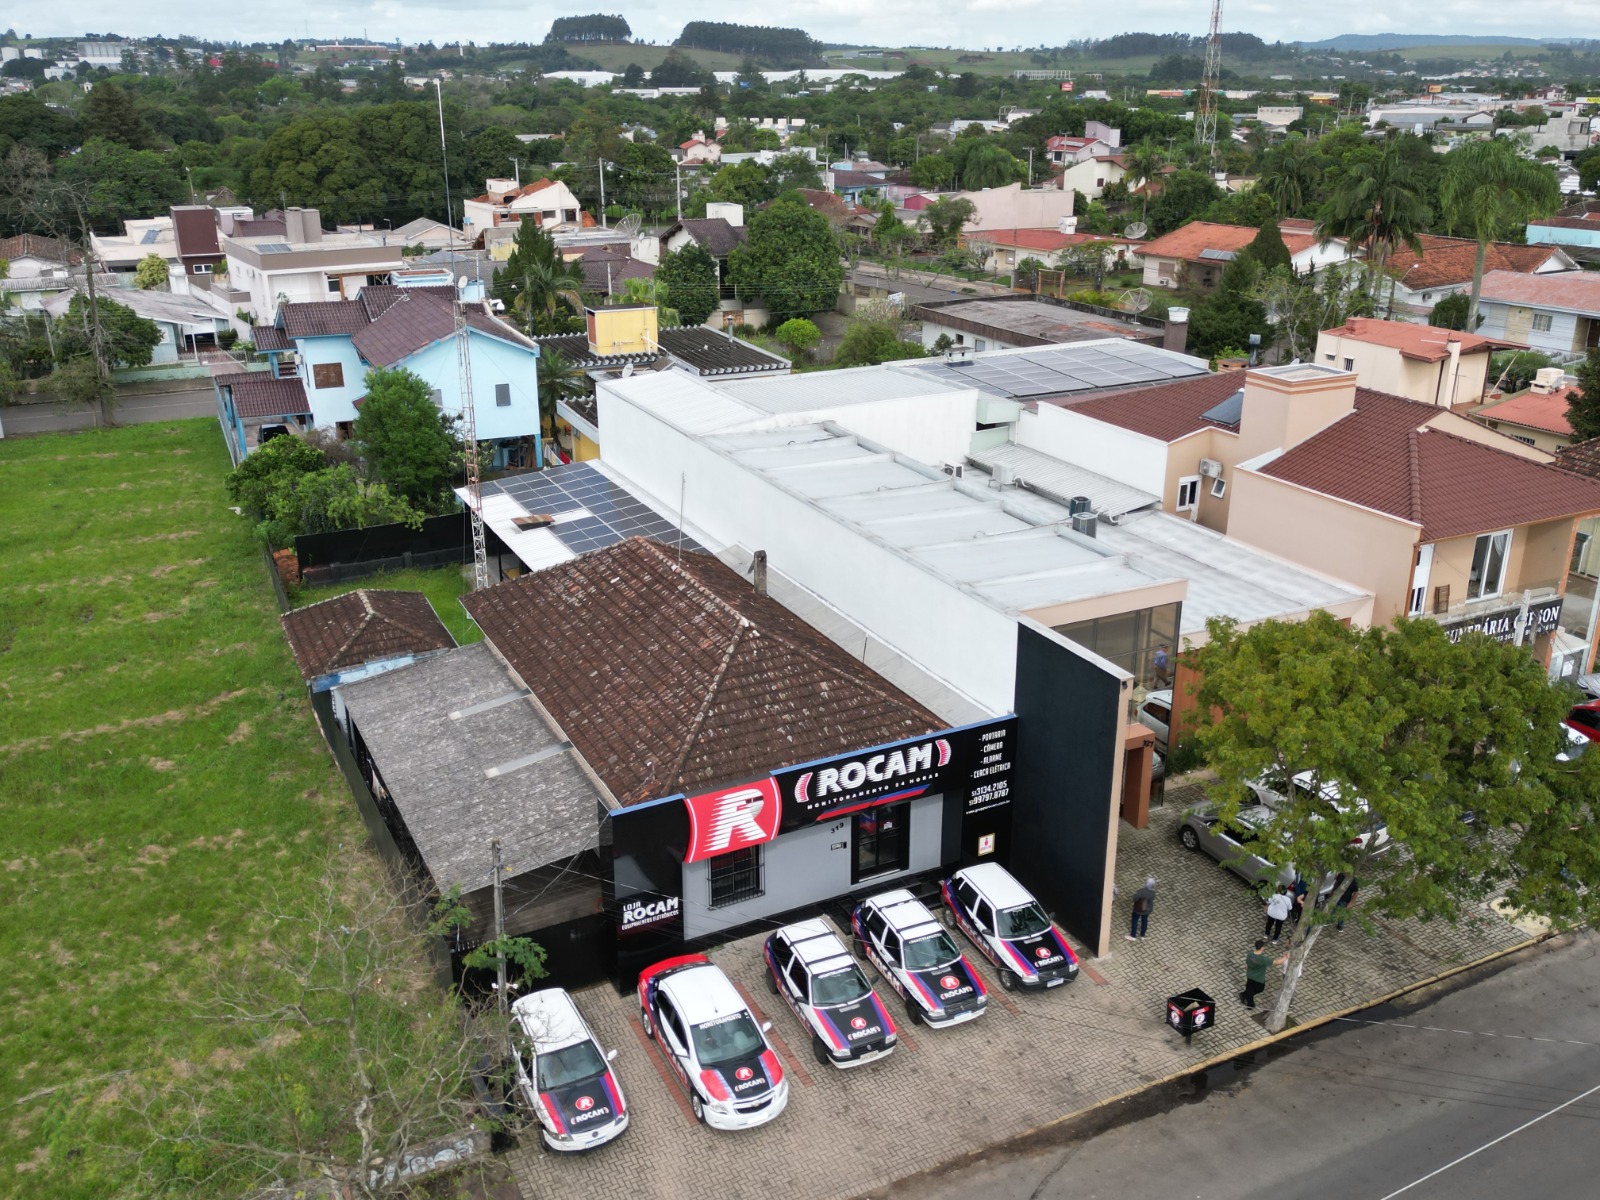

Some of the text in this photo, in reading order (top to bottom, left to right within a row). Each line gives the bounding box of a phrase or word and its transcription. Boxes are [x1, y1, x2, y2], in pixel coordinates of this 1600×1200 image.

[807, 785, 889, 810] MONITORAMENTO
[909, 772, 940, 785] HORAS
[622, 896, 679, 924] ROCAM
[623, 901, 641, 912] LOJA
